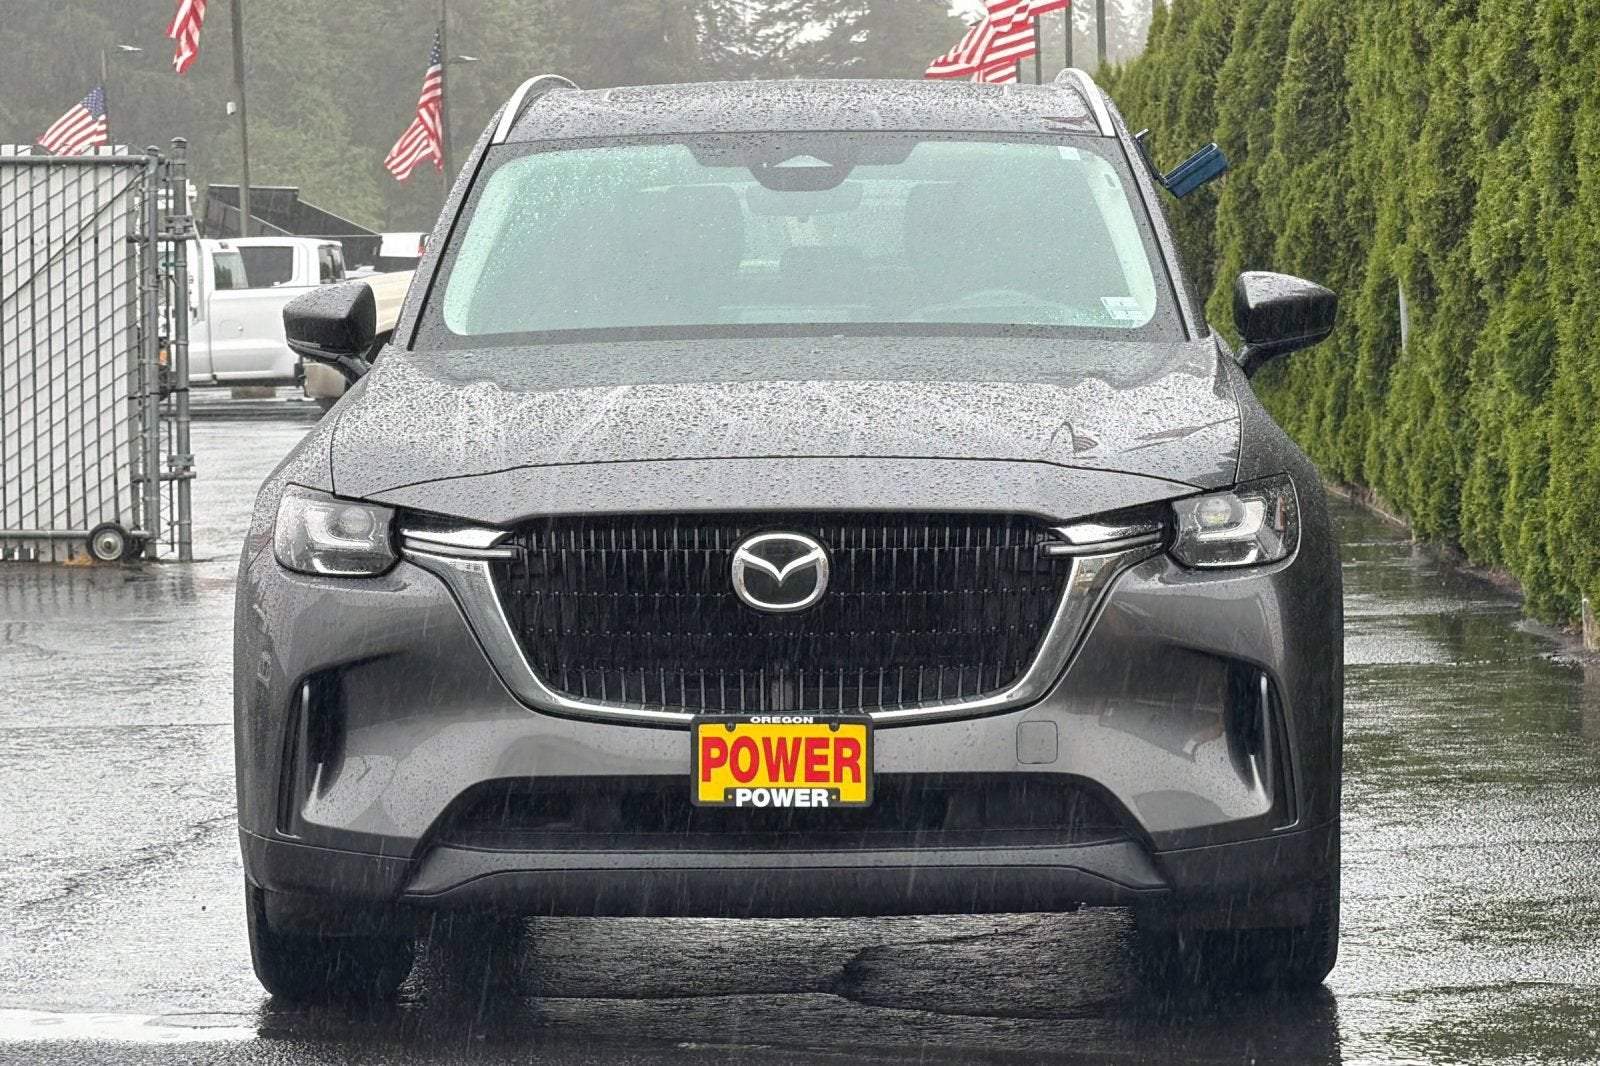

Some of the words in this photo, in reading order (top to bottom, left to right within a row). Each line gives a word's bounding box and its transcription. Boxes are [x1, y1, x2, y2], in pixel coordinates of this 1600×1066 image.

[750, 716, 813, 724] OREGON
[701, 735, 861, 783] POWER
[735, 788, 829, 807] POWER
